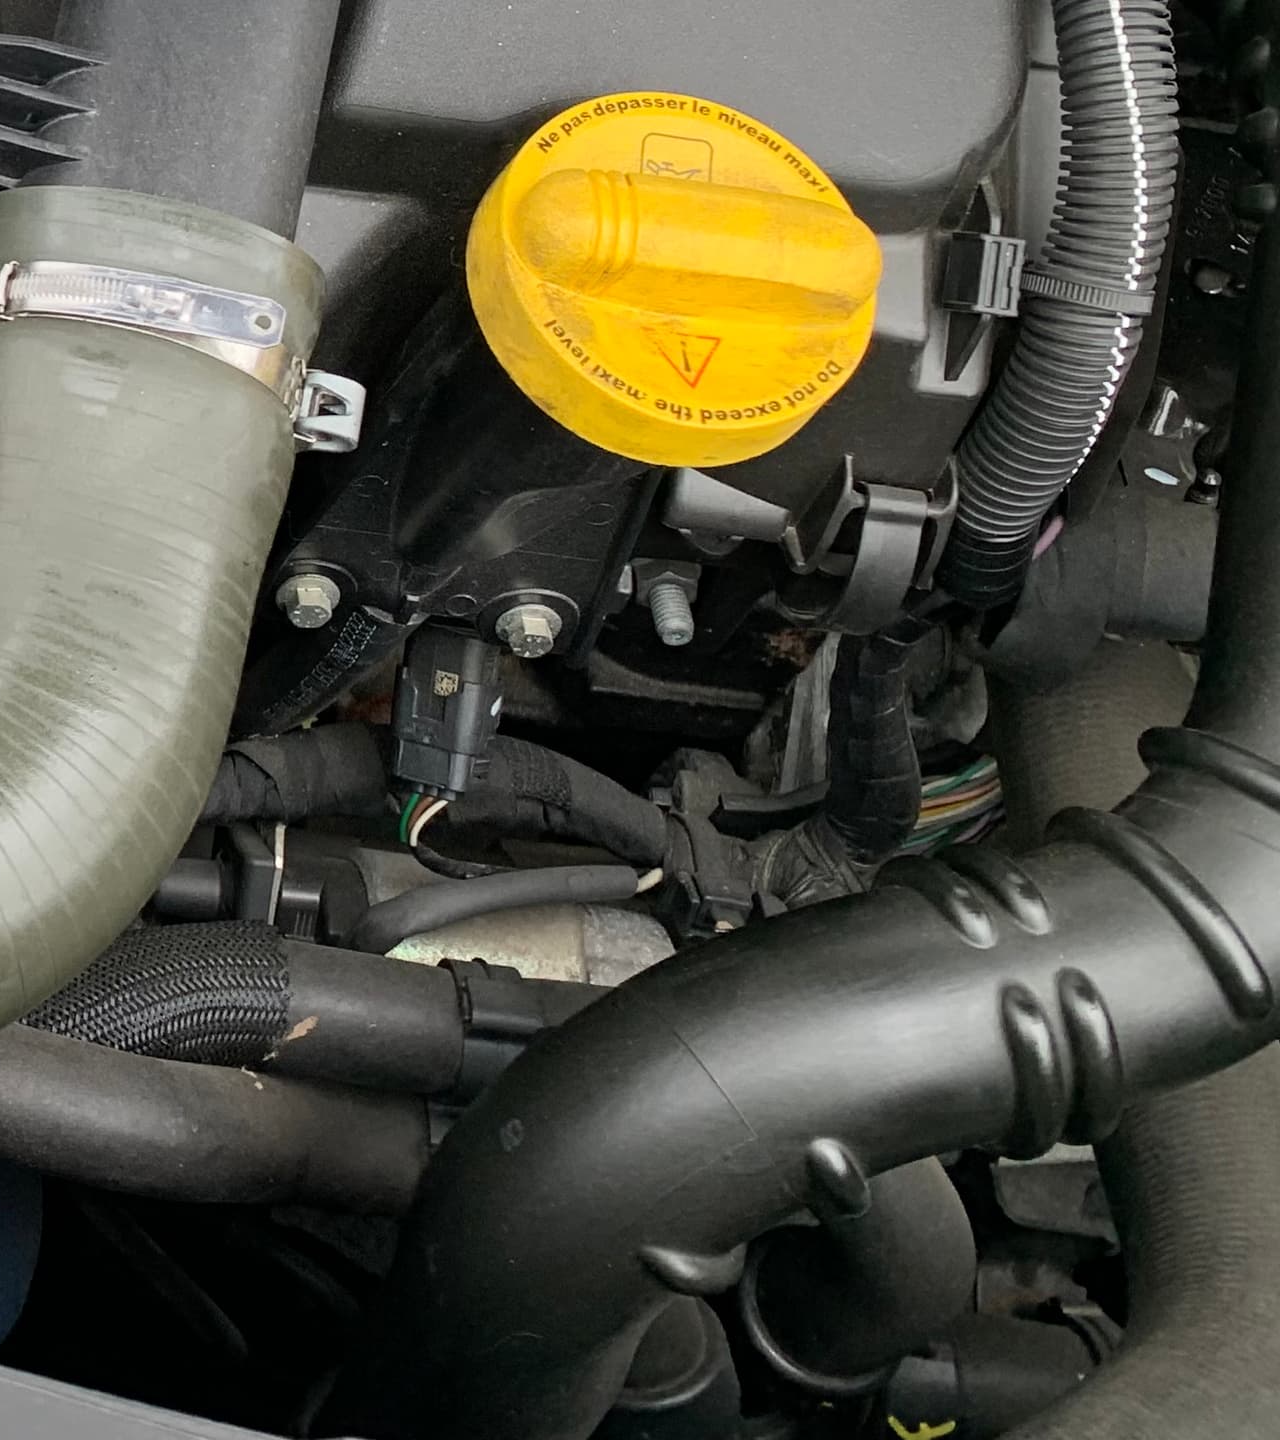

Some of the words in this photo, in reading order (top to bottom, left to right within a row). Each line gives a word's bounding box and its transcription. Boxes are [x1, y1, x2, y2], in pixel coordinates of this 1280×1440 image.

[536, 131, 558, 154] Ne
[560, 109, 593, 136] pas
[592, 96, 688, 120] dépasser
[692, 100, 711, 116] le
[718, 110, 782, 153] niveau
[784, 154, 829, 194] maxi
[544, 319, 591, 366] level
[592, 365, 647, 403] maxi
[817, 359, 843, 385] Do
[784, 382, 818, 409] not
[655, 398, 693, 422] the
[700, 400, 782, 426] exceed
